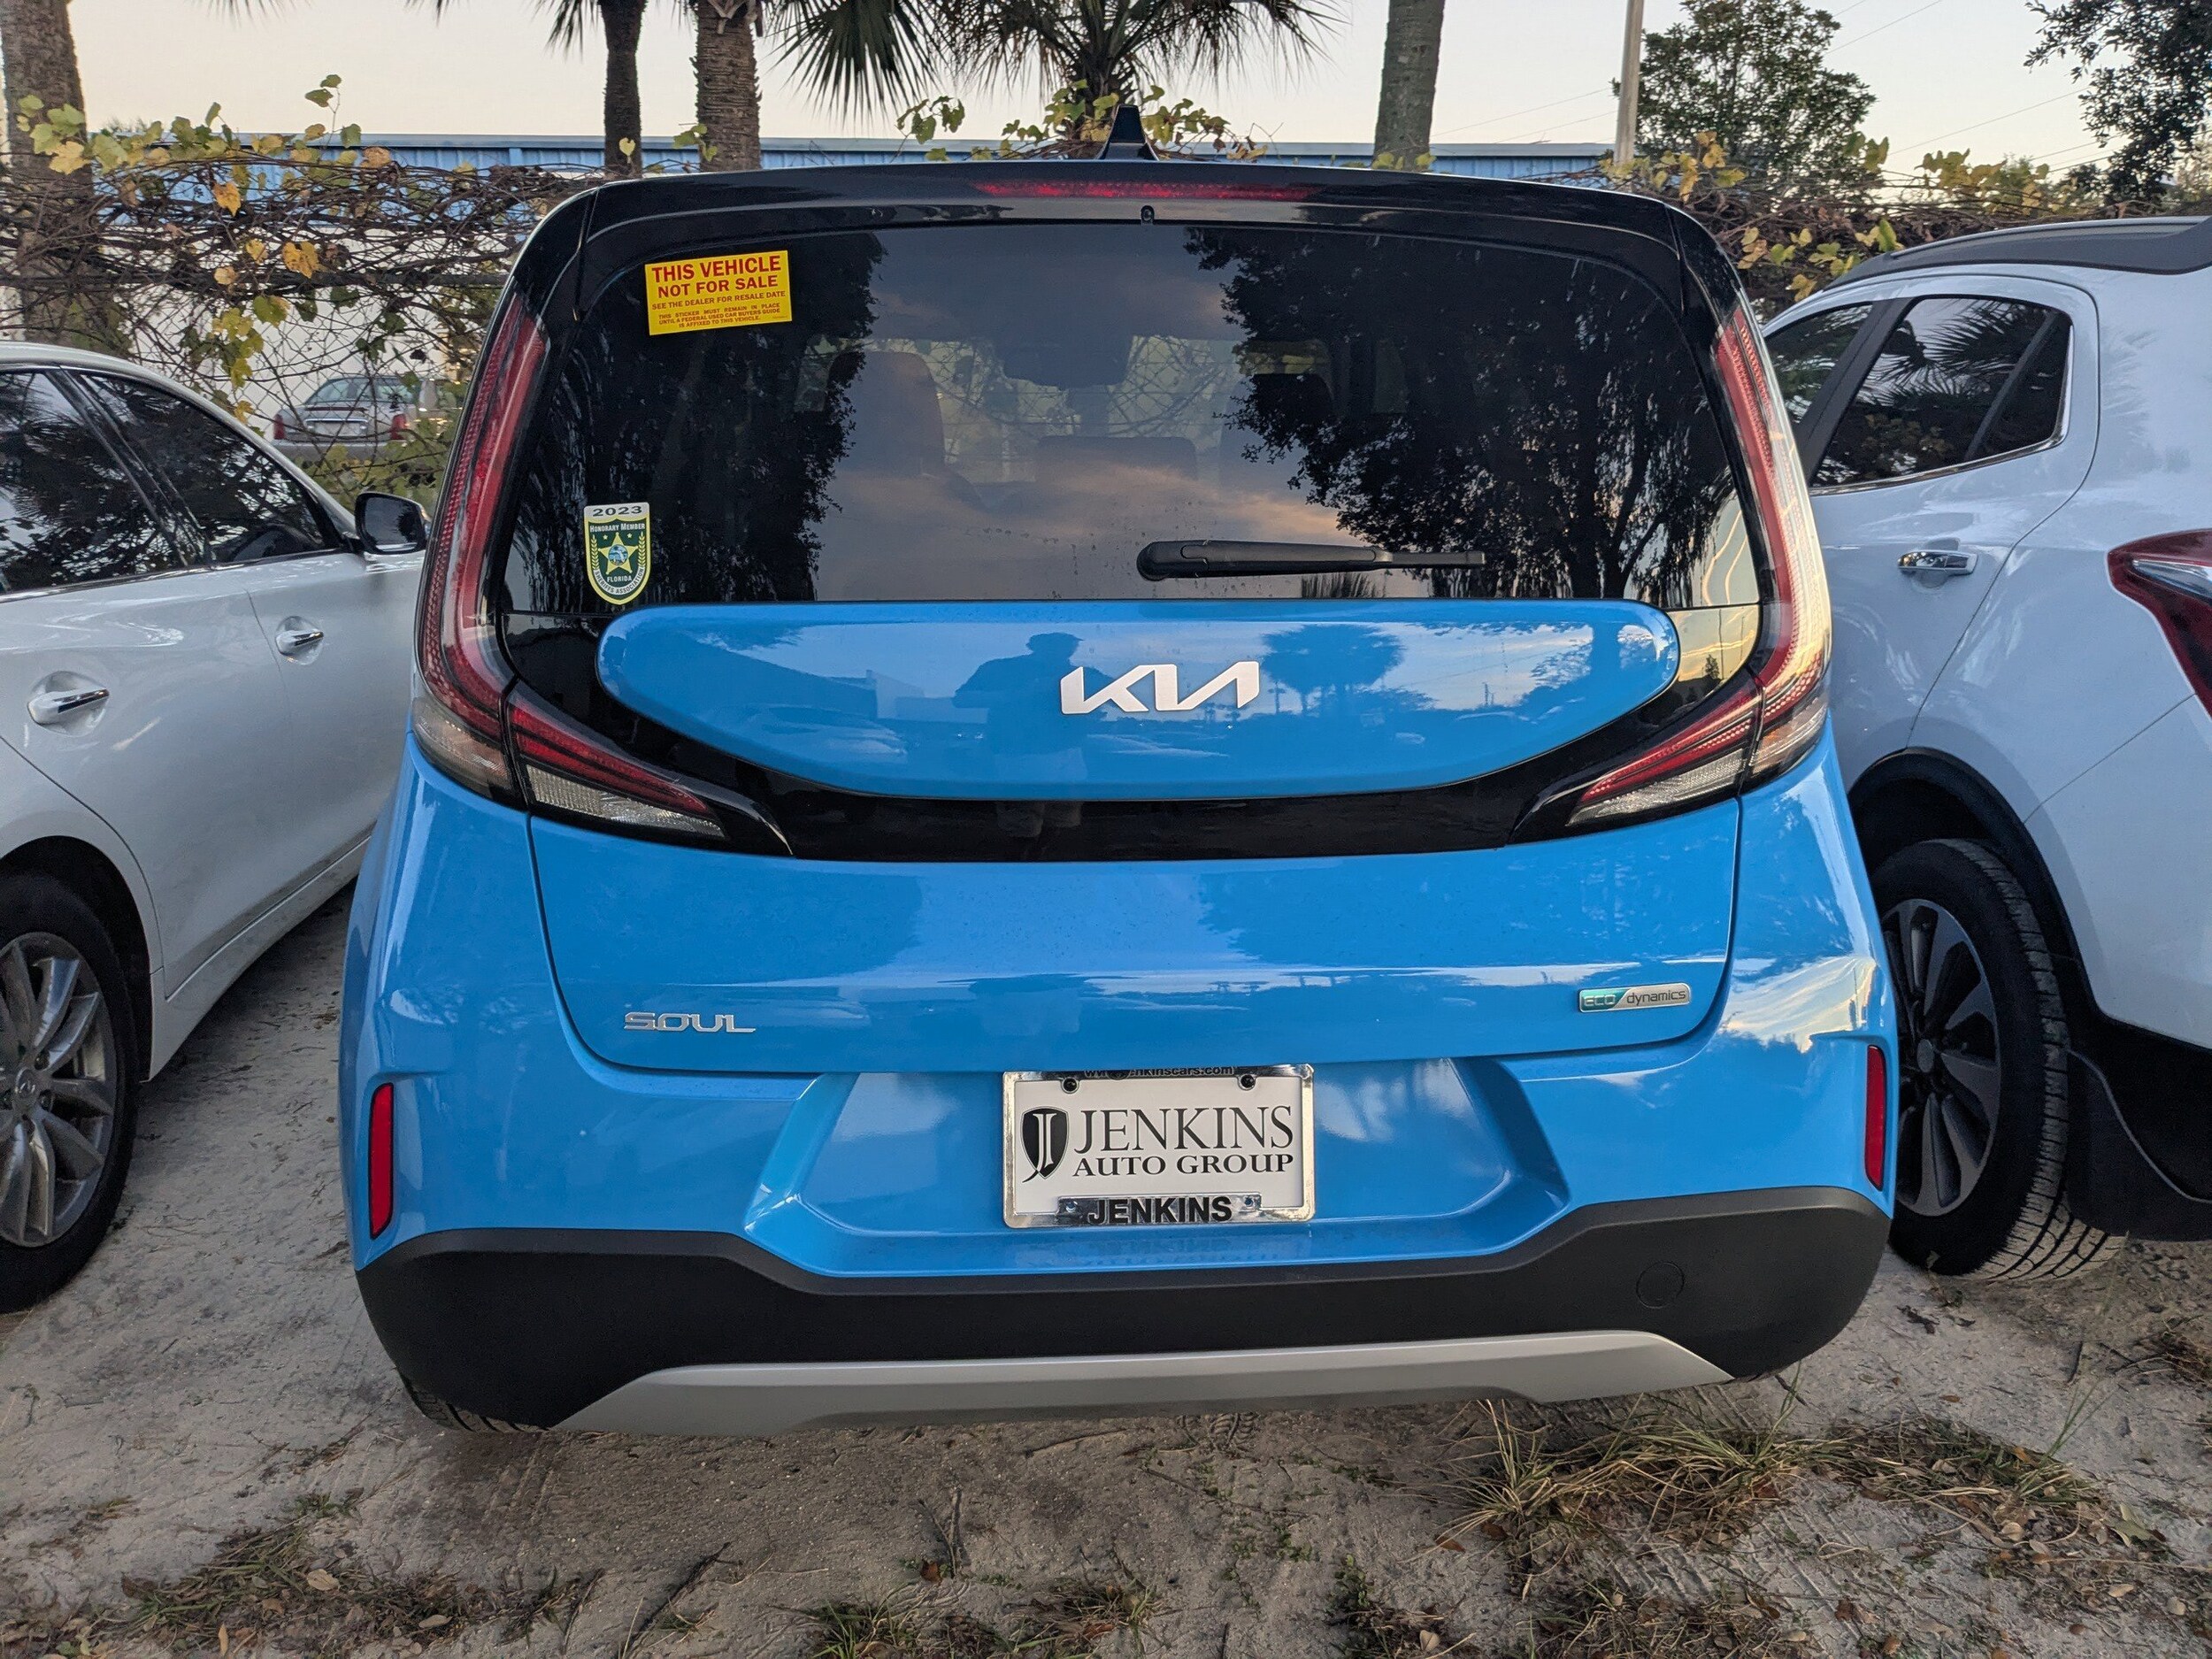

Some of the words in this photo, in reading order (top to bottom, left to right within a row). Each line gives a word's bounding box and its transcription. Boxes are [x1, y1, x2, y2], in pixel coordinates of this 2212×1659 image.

[652, 264, 695, 283] THIS
[700, 255, 781, 278] VEHICLE
[657, 283, 690, 298] NOT
[696, 280, 730, 295] FOR
[735, 275, 778, 290] SALE
[652, 302, 666, 311] SEE
[668, 300, 683, 309] THE
[685, 297, 715, 307] DEALER
[734, 293, 764, 302] RESALE
[592, 505, 642, 517] 2023
[589, 524, 619, 533] HONORARY
[594, 570, 614, 593] SHERIFFS
[615, 568, 644, 595] ASSOCIATION
[1060, 661, 1260, 715] KIA
[1583, 994, 1616, 1007] ECO
[1626, 989, 1686, 1006] dynamics
[624, 1011, 757, 1033] SOUL
[1073, 1105, 1294, 1154] JENKINS
[1072, 1155, 1166, 1177] AUTO
[1177, 1154, 1294, 1175] GROUP
[1087, 1196, 1233, 1225] JENKINS
